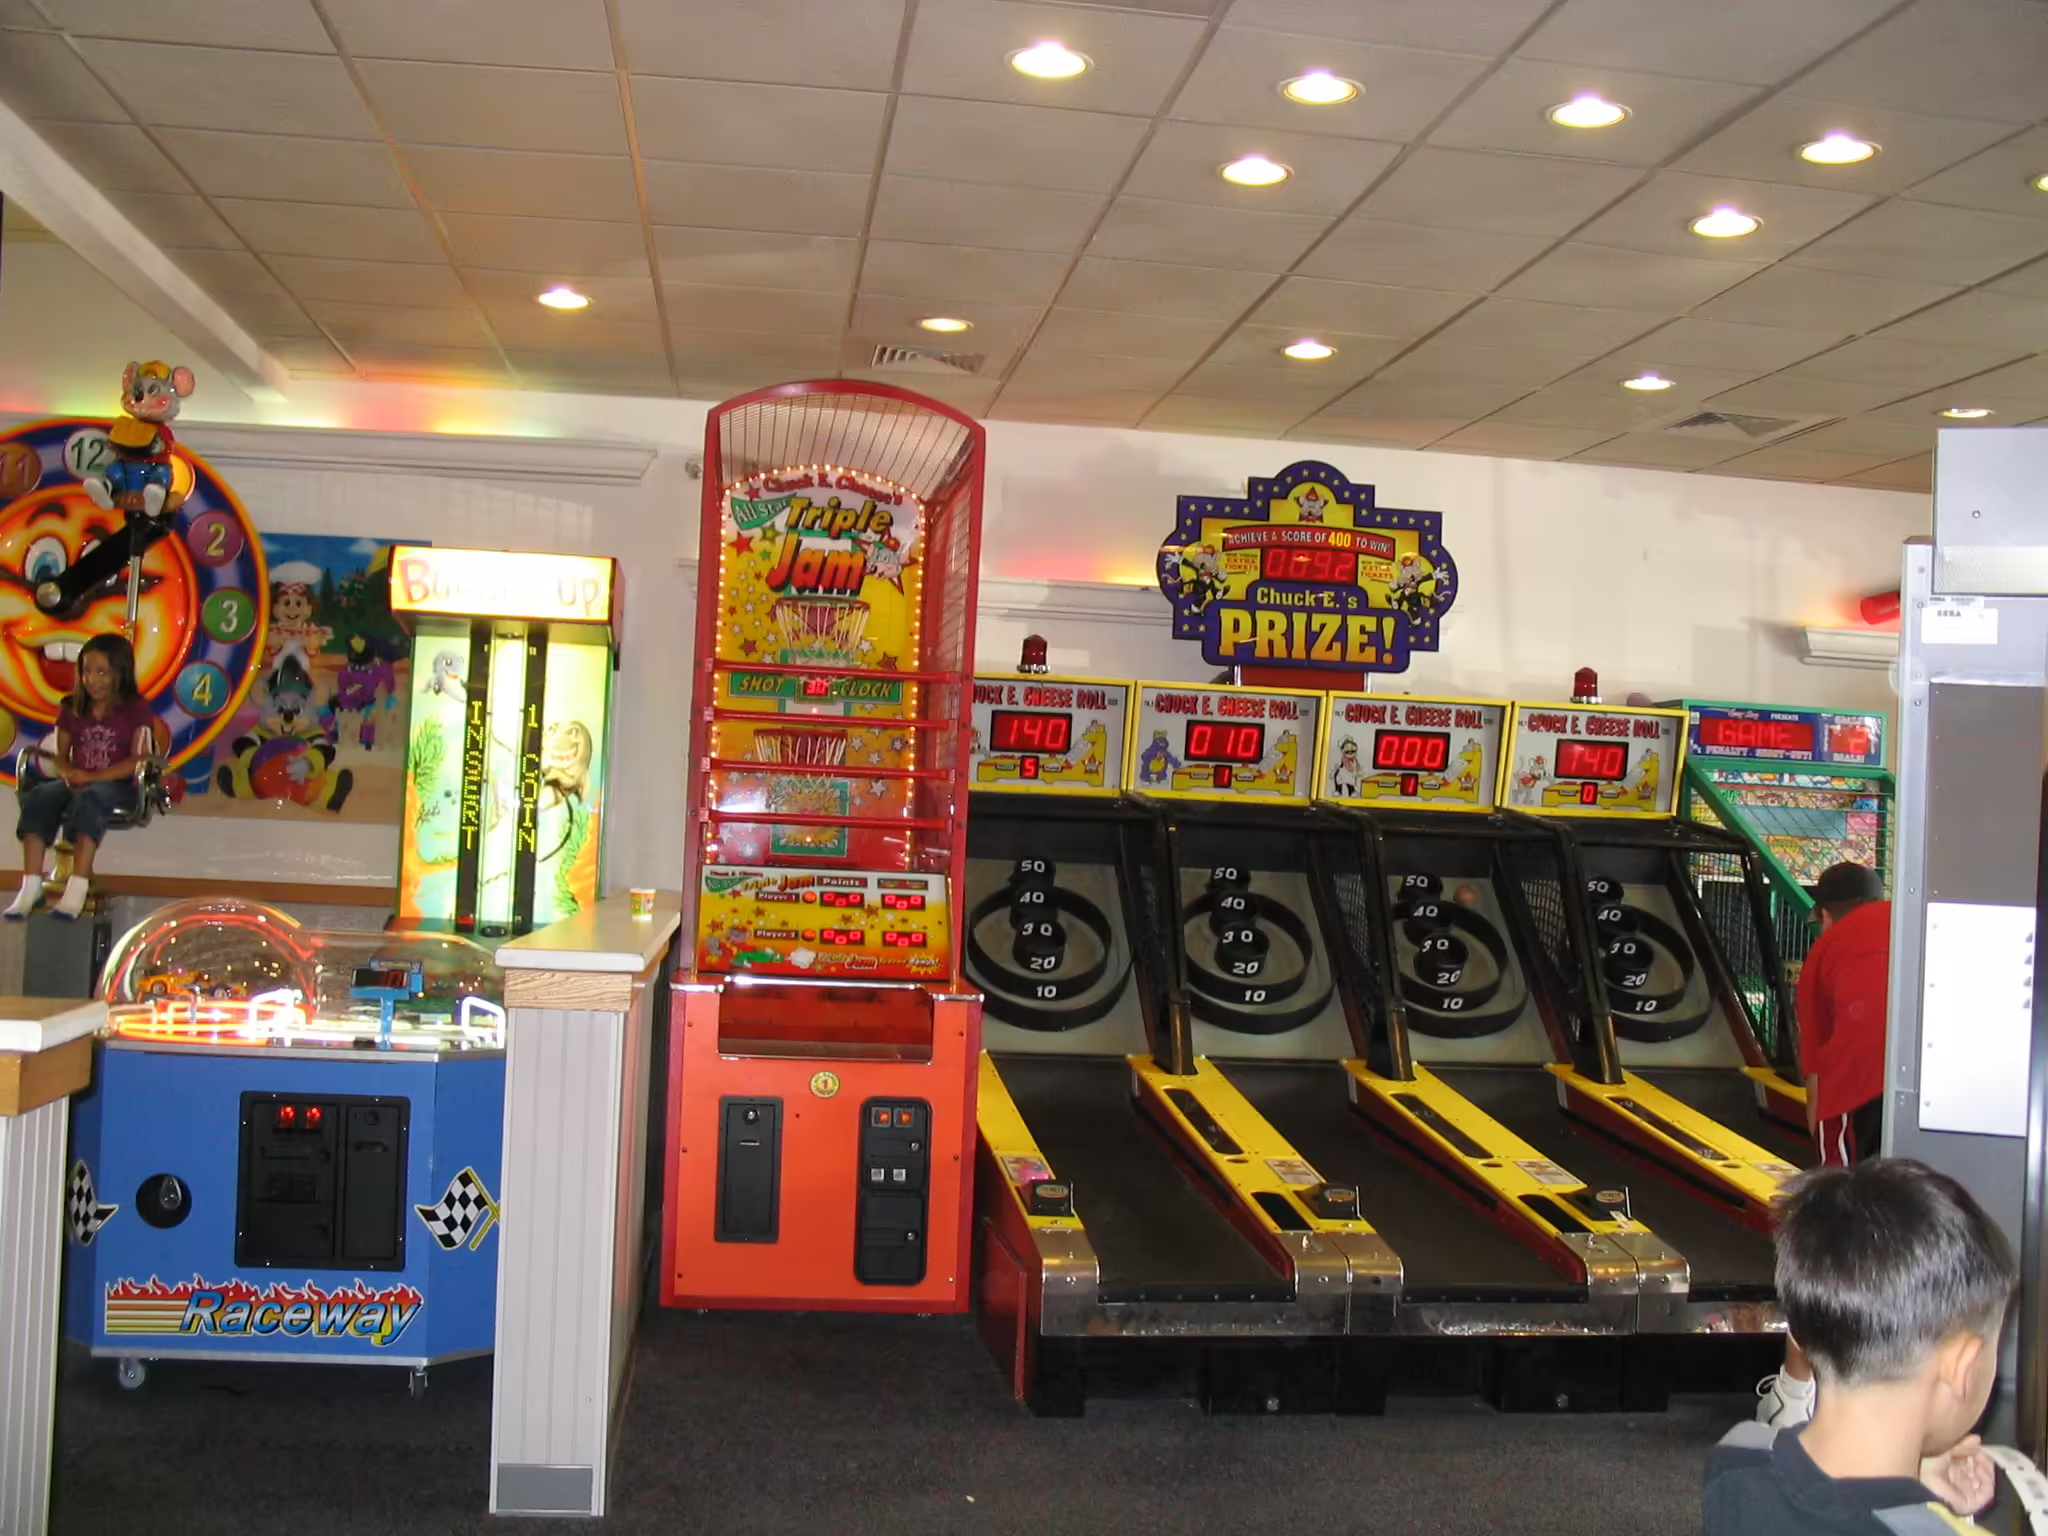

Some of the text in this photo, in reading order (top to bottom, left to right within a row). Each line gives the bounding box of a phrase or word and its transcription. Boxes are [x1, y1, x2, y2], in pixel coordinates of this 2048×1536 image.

[70, 438, 105, 471] 12
[735, 504, 757, 523] All
[787, 496, 894, 539] Triple
[207, 524, 226, 556] 2
[1228, 531, 1268, 545] ACHIEVE
[1282, 531, 1311, 543] SCORE
[1314, 531, 1327, 543] OF
[1328, 531, 1351, 547] 400
[1356, 537, 1367, 549] TO
[766, 533, 867, 596] Jam
[1256, 586, 1316, 608] Chuck
[220, 602, 239, 633] 3
[1219, 608, 1396, 665] PRIZE!
[192, 674, 212, 706] 4
[740, 676, 785, 693] SHOT
[840, 682, 895, 697] CLOCK
[1023, 687, 1073, 708] CHEESE
[1076, 689, 1107, 710] ROLL
[1154, 693, 1198, 715] CHUCK
[1202, 695, 1213, 716] E.
[1217, 696, 1266, 719] CHEESE
[1269, 698, 1299, 720] ROLL
[1344, 703, 1483, 729] CHUCK E. CHEESE ROLL
[1010, 719, 1067, 749] 140
[1528, 713, 1567, 734] CHUCK
[1586, 716, 1631, 737] CHEESE
[1633, 719, 1660, 739] ROLL
[1190, 725, 1260, 758] 010
[1718, 721, 1793, 749] GAME
[1378, 736, 1444, 767] 000
[1025, 757, 1034, 777] 5
[1224, 768, 1229, 784] 1
[1408, 777, 1415, 793] 1
[1583, 786, 1594, 802] 0
[1021, 860, 1046, 873] 50
[1214, 867, 1237, 880] 50
[822, 877, 860, 887] Points
[1405, 875, 1428, 887] 50
[1587, 881, 1609, 893] 50
[759, 893, 788, 903] Player
[1020, 892, 1045, 904] 40
[1221, 897, 1245, 910] 40
[1413, 905, 1438, 918] 40
[1598, 910, 1622, 922] 40
[756, 930, 788, 940] Player
[1030, 956, 1056, 970] 20
[1232, 962, 1258, 975] 20
[1437, 970, 1461, 984] 20
[1622, 973, 1647, 986] 20
[1036, 985, 1057, 998] 10
[1244, 990, 1266, 1002] 10
[1442, 998, 1463, 1010] 10
[1635, 1000, 1657, 1012] 10
[180, 1290, 424, 1346] Raceway
